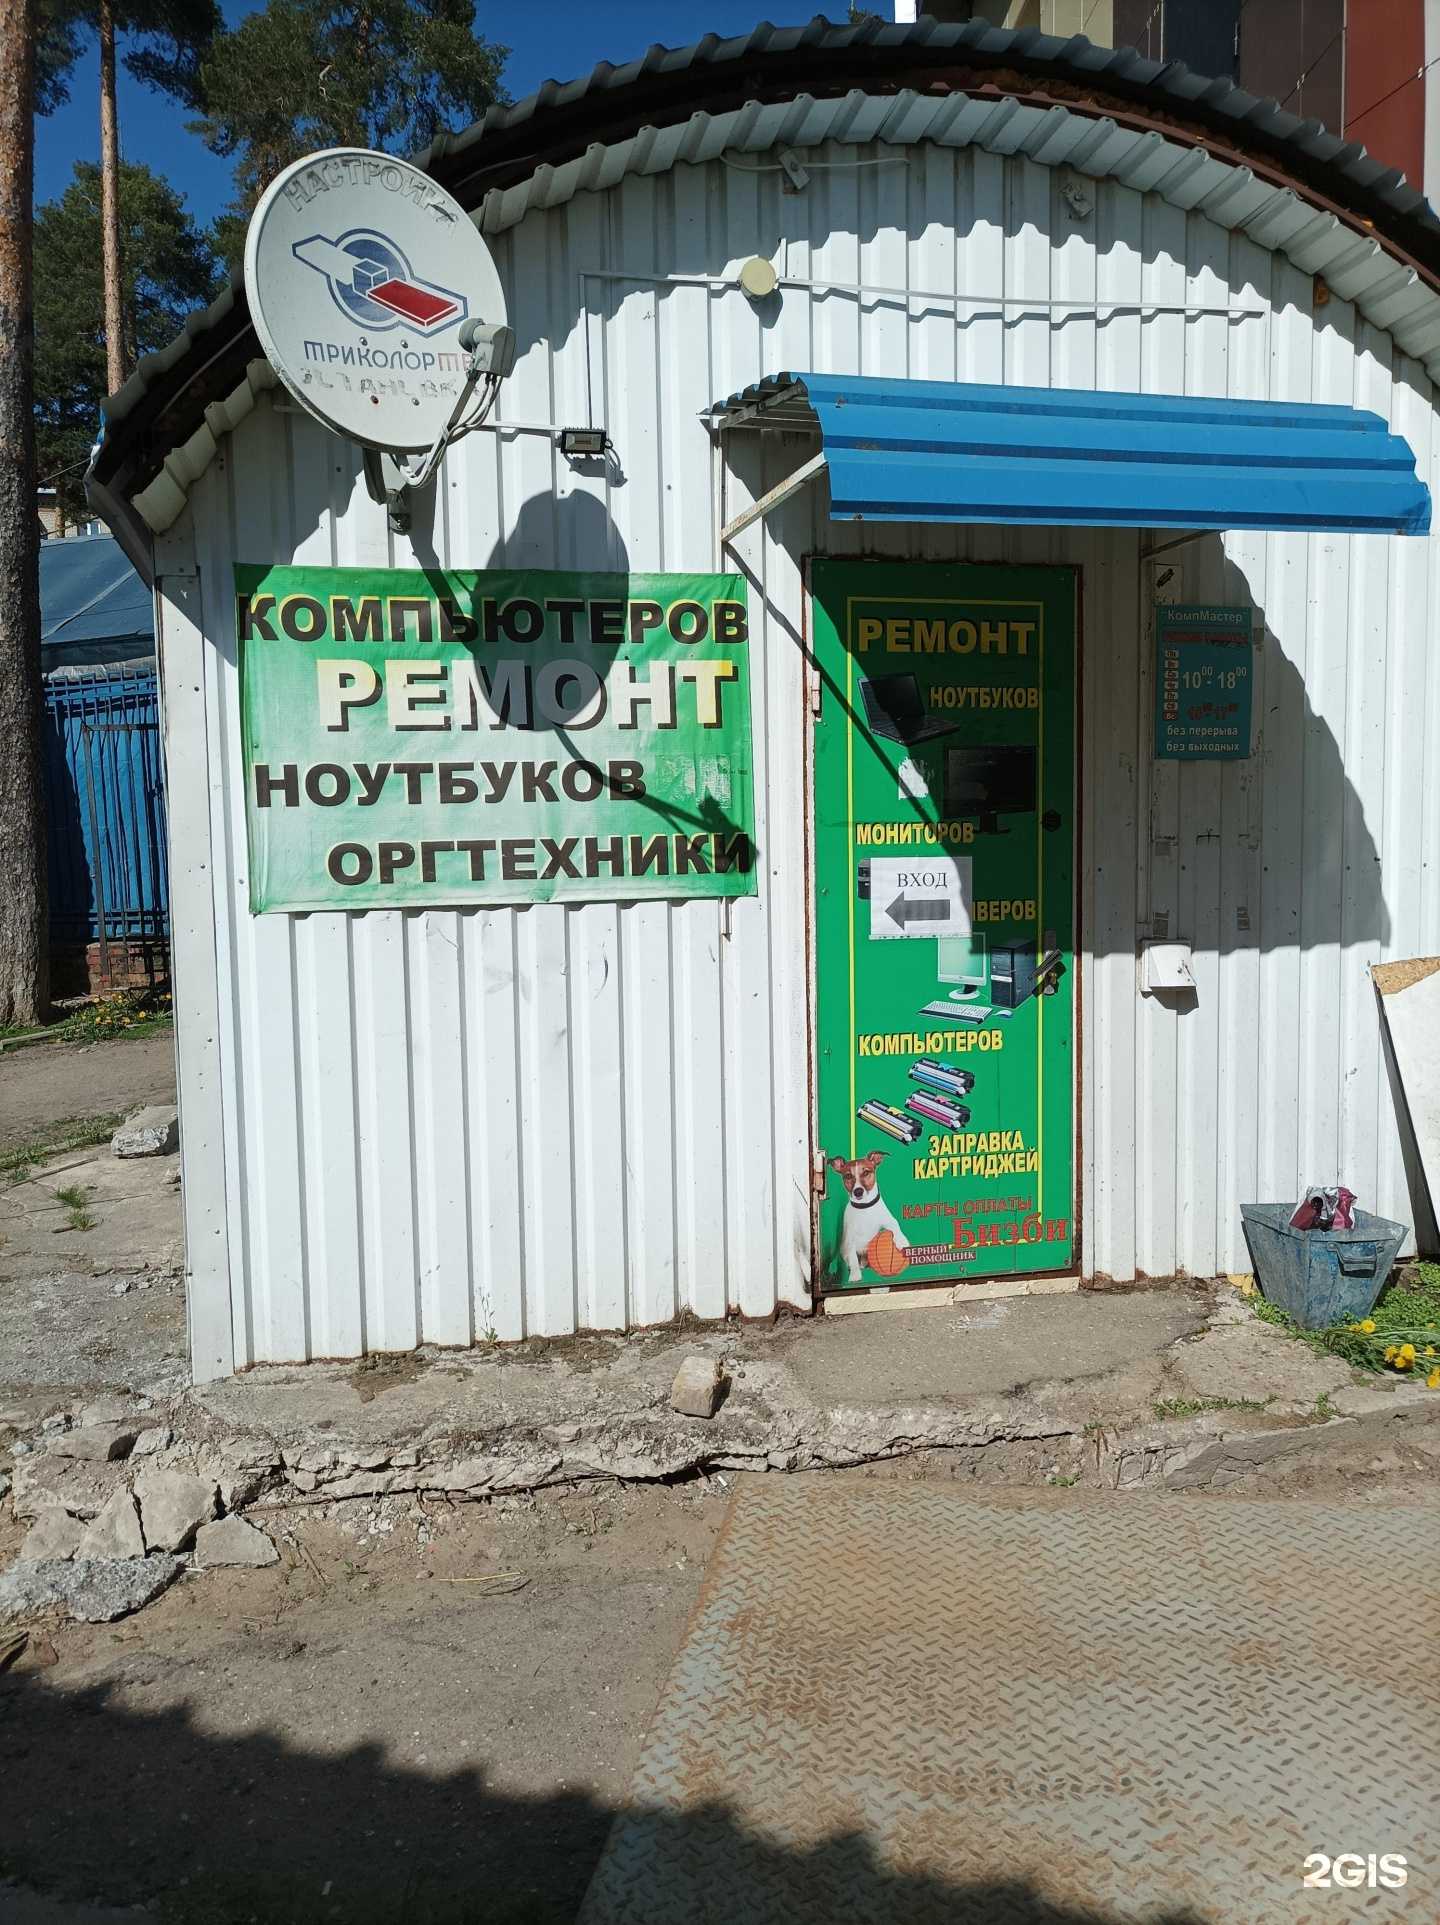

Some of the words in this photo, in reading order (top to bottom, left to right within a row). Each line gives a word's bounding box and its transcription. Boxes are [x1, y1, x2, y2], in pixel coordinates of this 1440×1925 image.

[239, 593, 749, 644] КОМПЬЮТЕРОВ
[1168, 610, 1242, 624] КомпМастер
[858, 618, 1036, 655] РЕМОНТ
[316, 658, 738, 732] РЕМОНТ
[930, 687, 1038, 709] НОУТБУКОВ
[1167, 725, 1186, 736] без
[1189, 727, 1238, 736] перерыва
[1167, 742, 1185, 751] без
[1188, 744, 1240, 752] выходных
[254, 760, 647, 808] НОУТБУКОВ
[856, 822, 975, 845] МОНИТОРОВ
[326, 833, 750, 887] ОРГТЕХНИКИ
[896, 872, 949, 889] ВХОД
[971, 900, 1036, 921] ВЕРОВ
[859, 1030, 1003, 1056] КОМПЬЮТЕРОВ
[928, 1130, 1025, 1157] ЗАПРАВКА
[914, 1147, 1040, 1179] КАРТРИДЖЕЙ
[903, 1200, 958, 1219] КАРТЫ
[963, 1195, 1032, 1214] ОПЛАТЫ
[904, 1244, 948, 1257] ВЕРНЫЙ
[910, 1252, 975, 1265] ПОМОЩНИК
